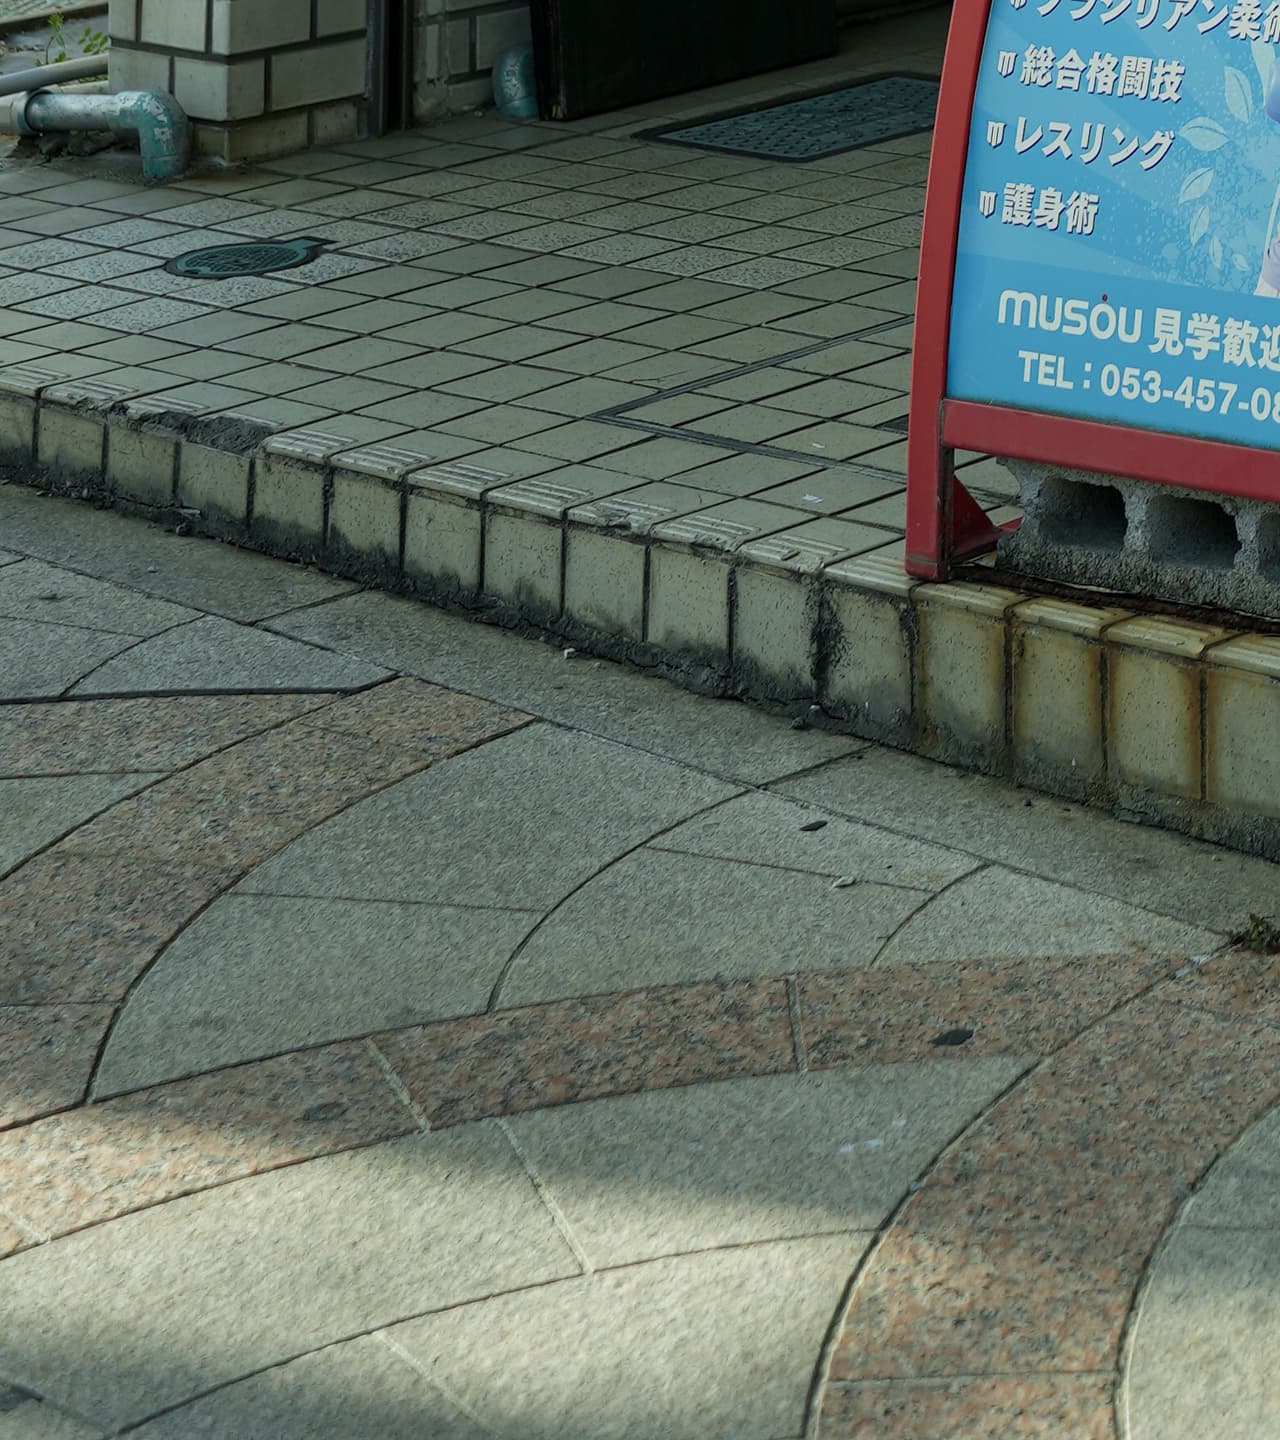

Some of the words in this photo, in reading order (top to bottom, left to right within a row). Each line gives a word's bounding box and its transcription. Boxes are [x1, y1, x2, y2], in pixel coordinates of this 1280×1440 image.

[1021, 47, 1187, 104] 総合格闘技
[1014, 115, 1175, 171] レスリング
[1002, 181, 1100, 237] 護身術
